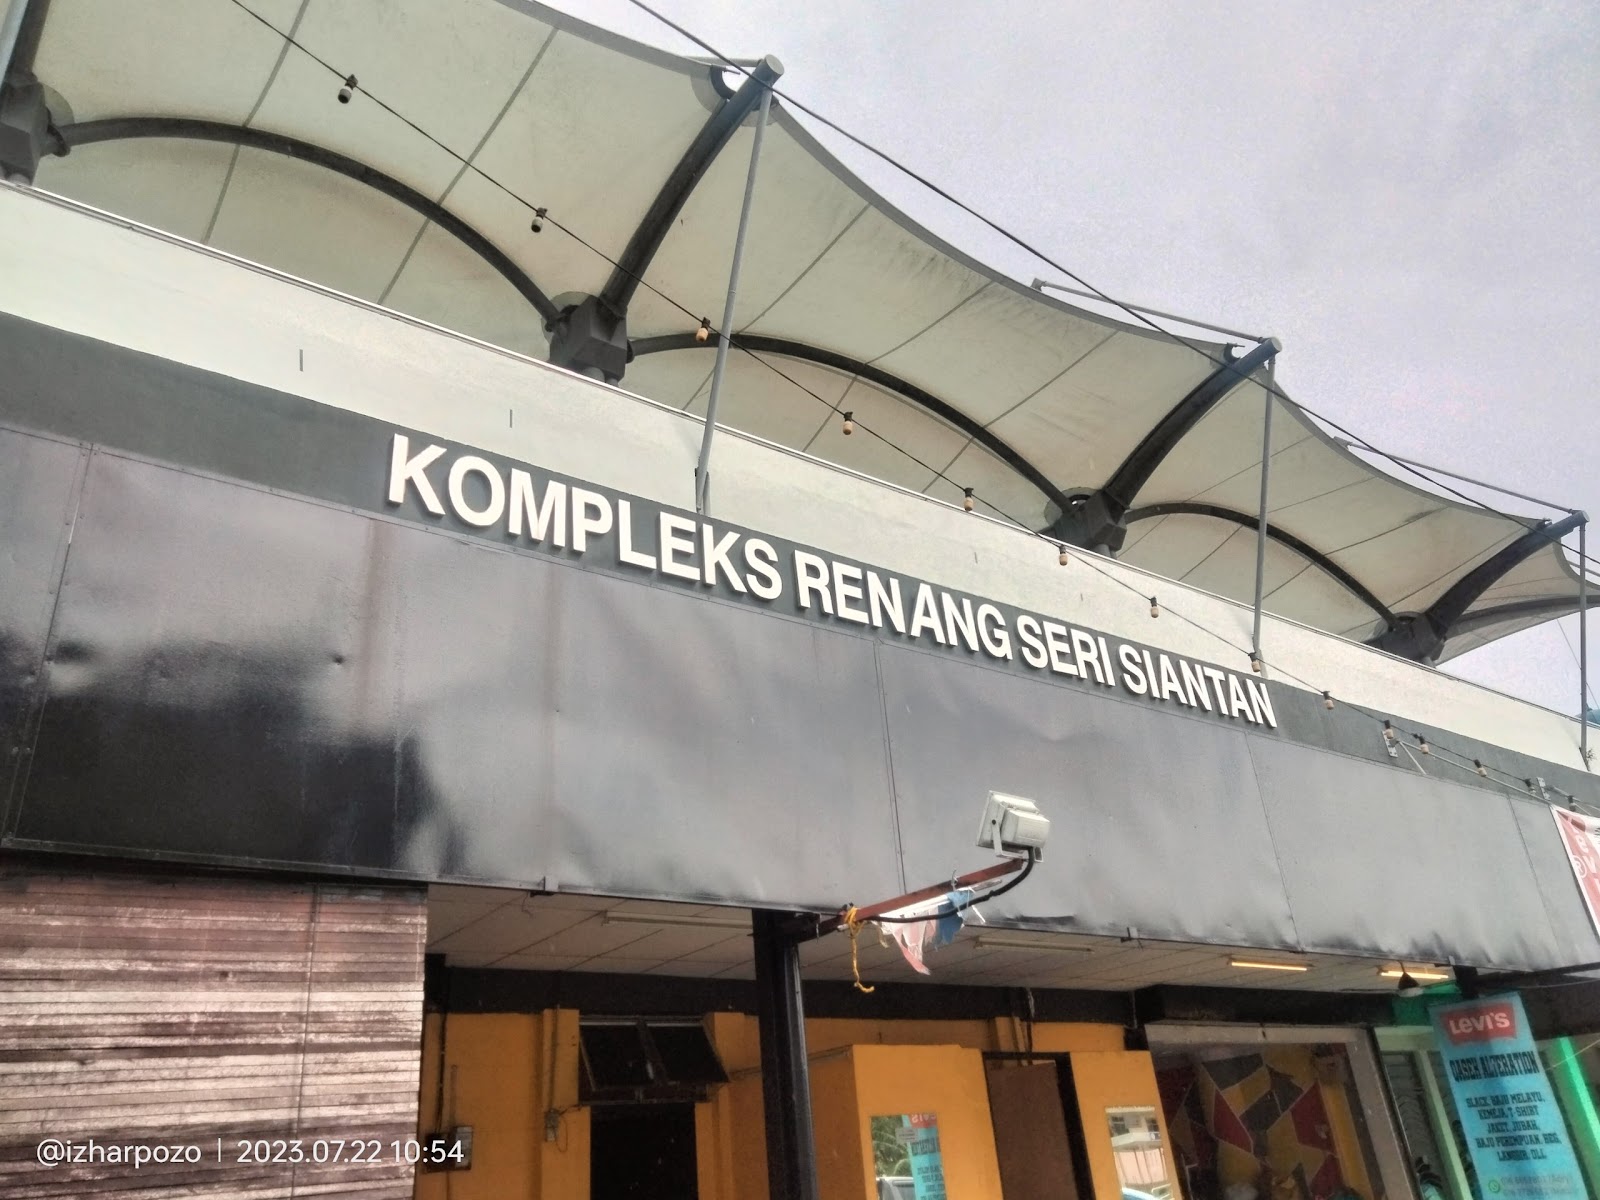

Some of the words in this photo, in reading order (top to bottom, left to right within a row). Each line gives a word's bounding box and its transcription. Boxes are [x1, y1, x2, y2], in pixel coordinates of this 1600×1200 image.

[388, 433, 783, 600] KOMPLEKS
[794, 550, 1013, 661] RENANG
[1016, 614, 1116, 687] SERI
[1118, 644, 1278, 728] SIANTAN
[1480, 1051, 1540, 1079] ALTERATION
